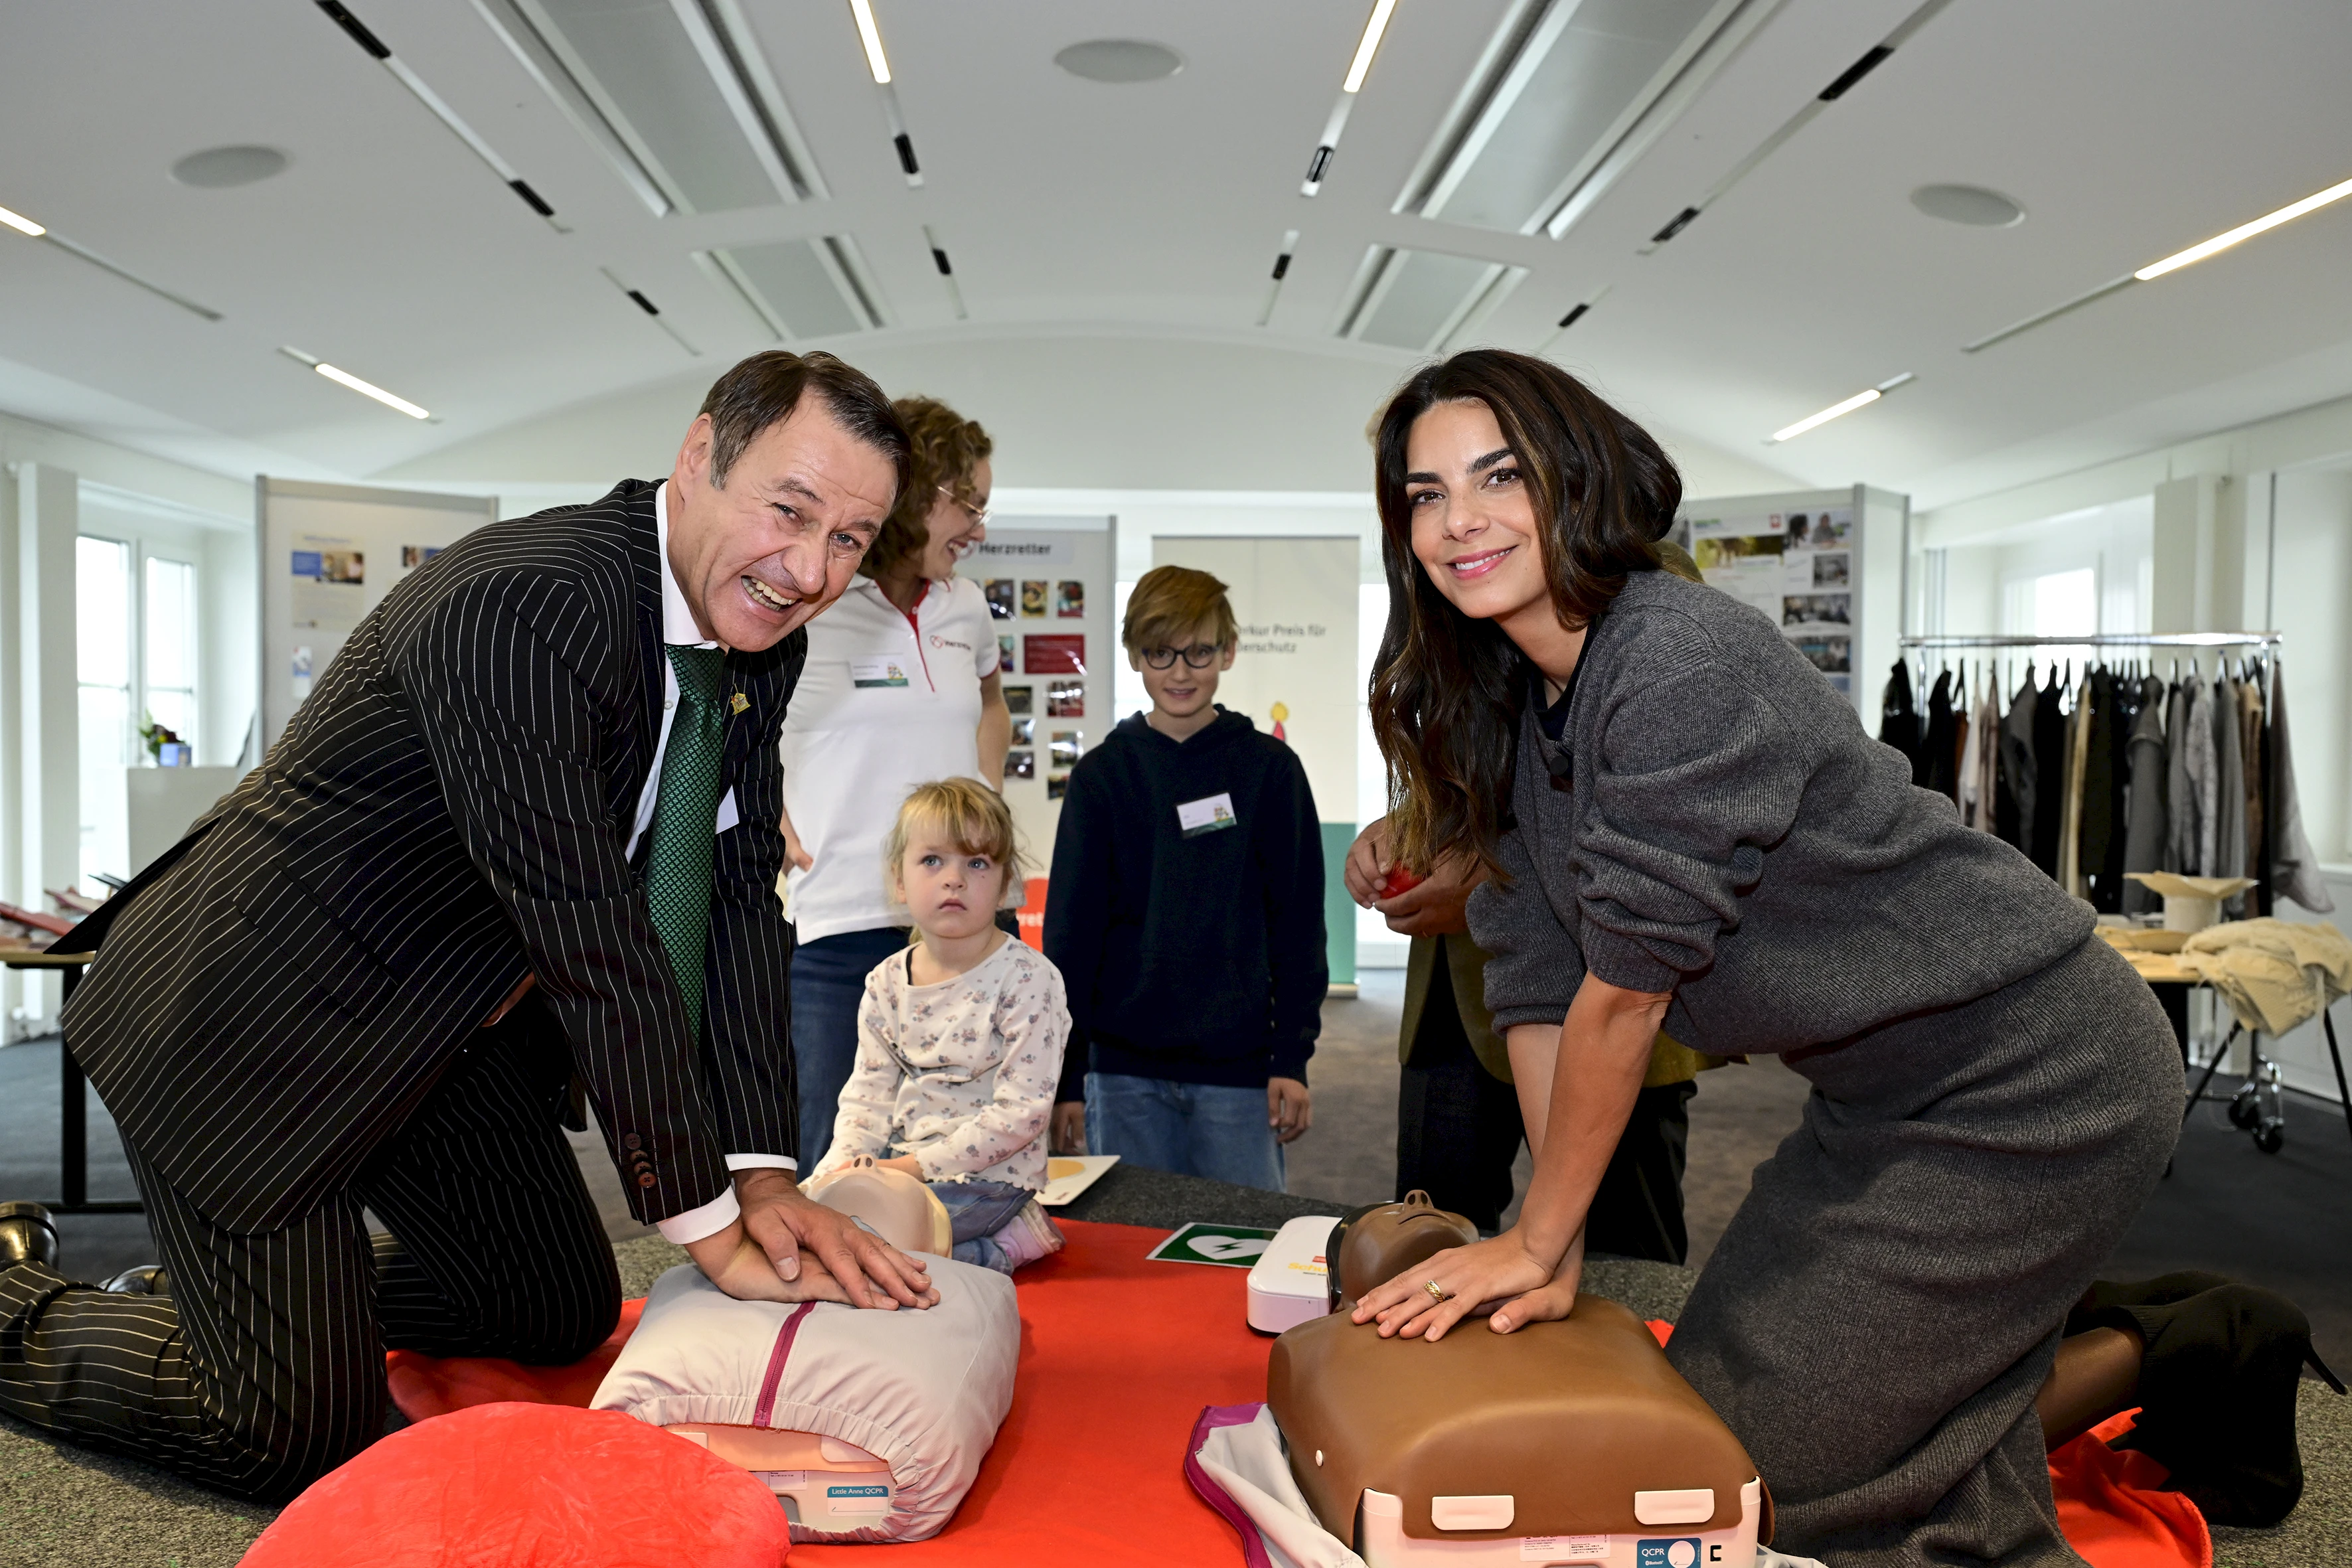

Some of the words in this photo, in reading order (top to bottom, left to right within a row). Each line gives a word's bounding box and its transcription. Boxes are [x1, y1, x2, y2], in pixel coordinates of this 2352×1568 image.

[1239, 623, 1269, 636] erkur
[1272, 623, 1305, 637] Preis
[1307, 623, 1326, 636] für
[1288, 1263, 1328, 1273] Schu
[1642, 1548, 1665, 1557] QCPR
